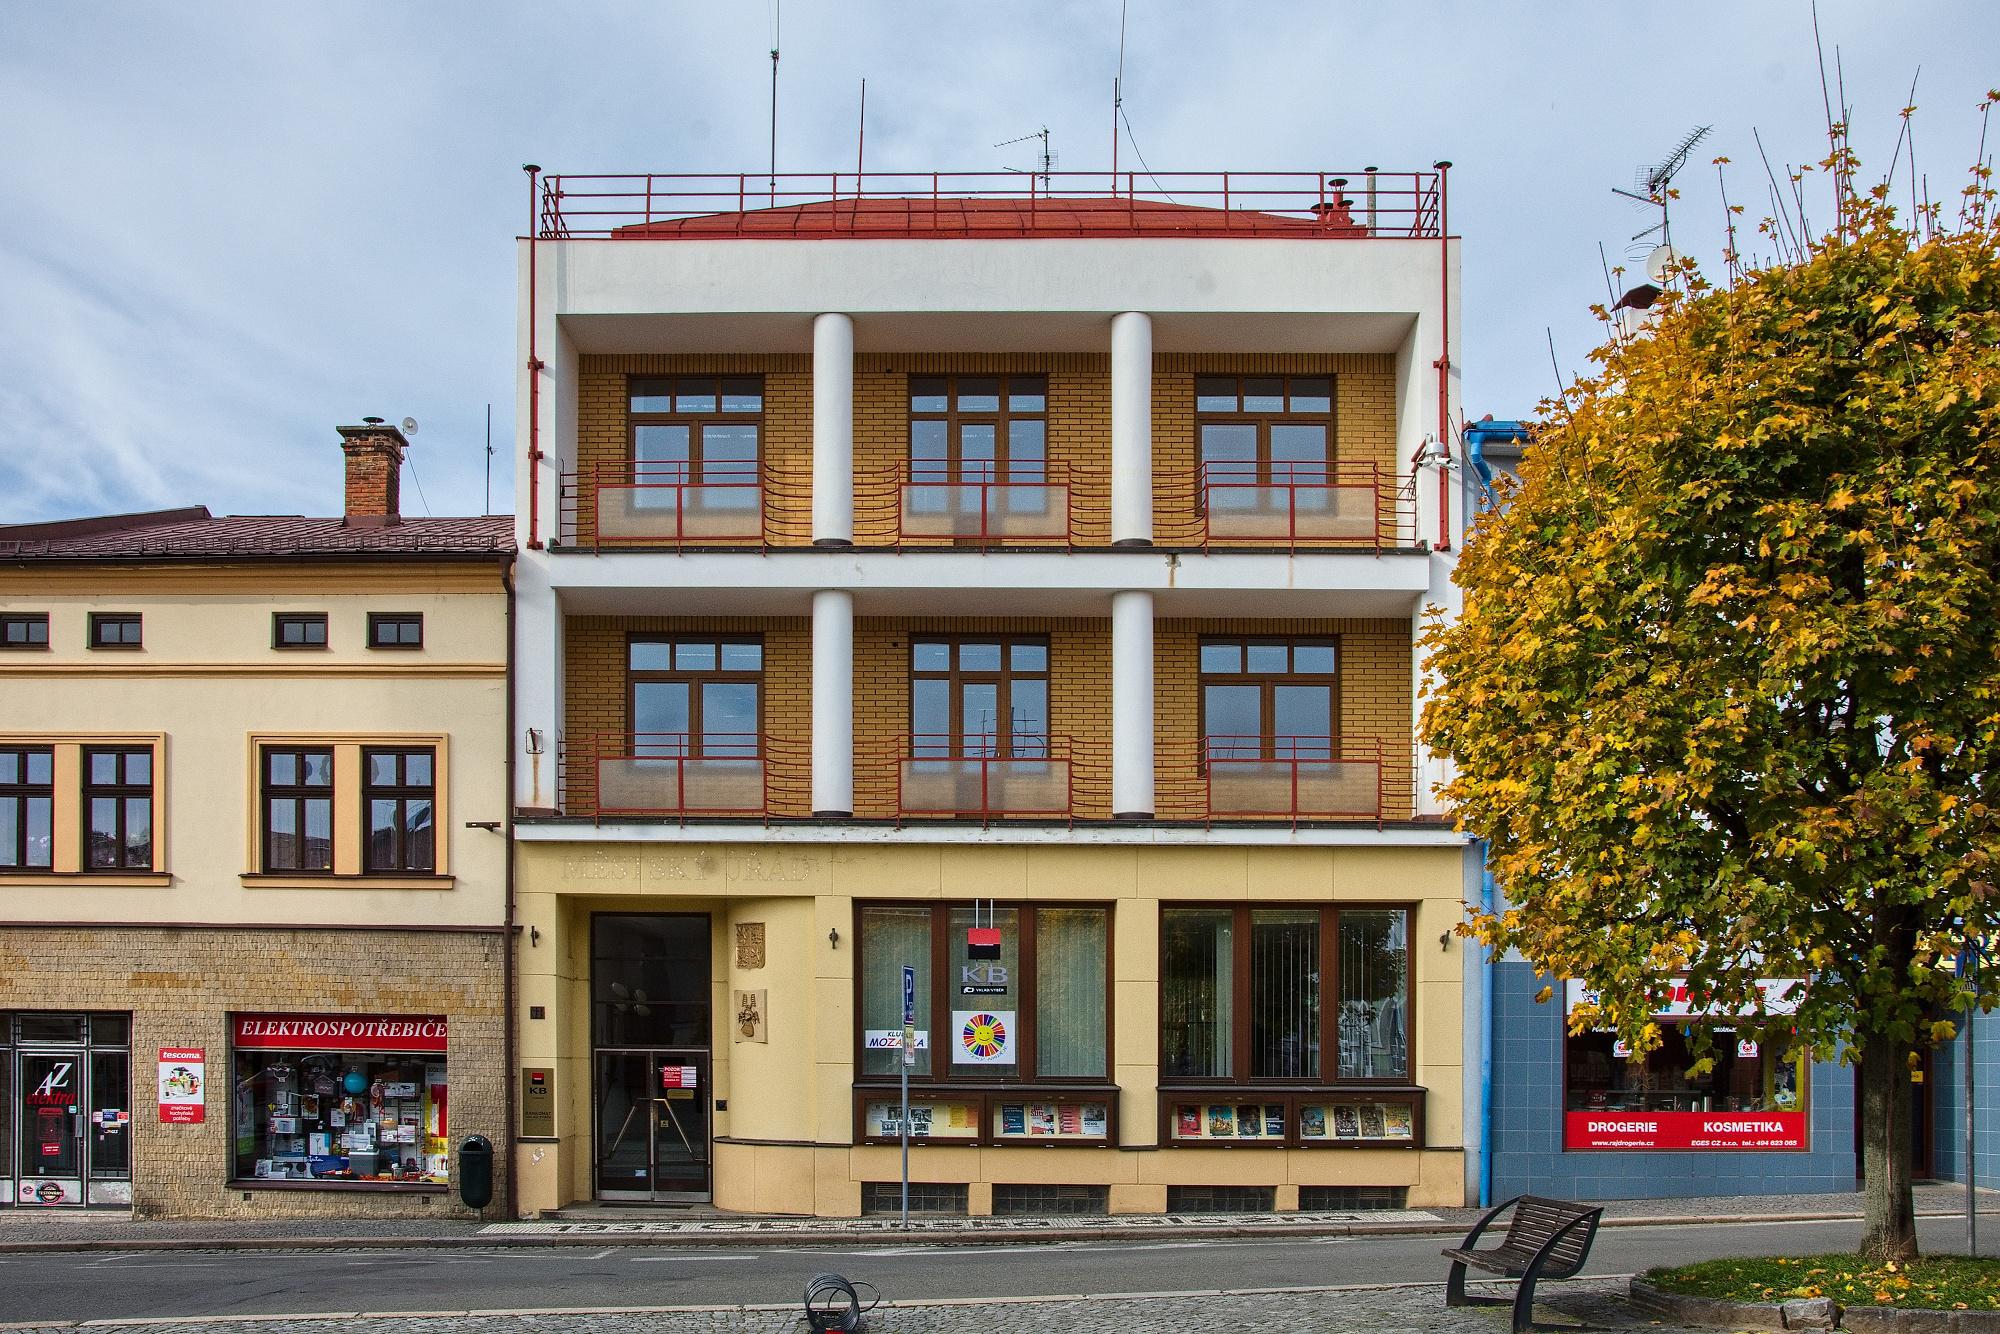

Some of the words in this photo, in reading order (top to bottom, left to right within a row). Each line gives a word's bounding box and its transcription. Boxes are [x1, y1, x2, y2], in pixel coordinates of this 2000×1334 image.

[961, 966, 1008, 983] KB
[241, 1018, 447, 1038] ELEKTROSPOTŘEBIČE
[33, 1062, 73, 1095] AZ
[529, 1087, 548, 1095] KB
[1588, 1121, 1657, 1133] DROGERIE
[1703, 1121, 1783, 1133] KOSMETIKA
[549, 1223, 682, 1232] 1933
